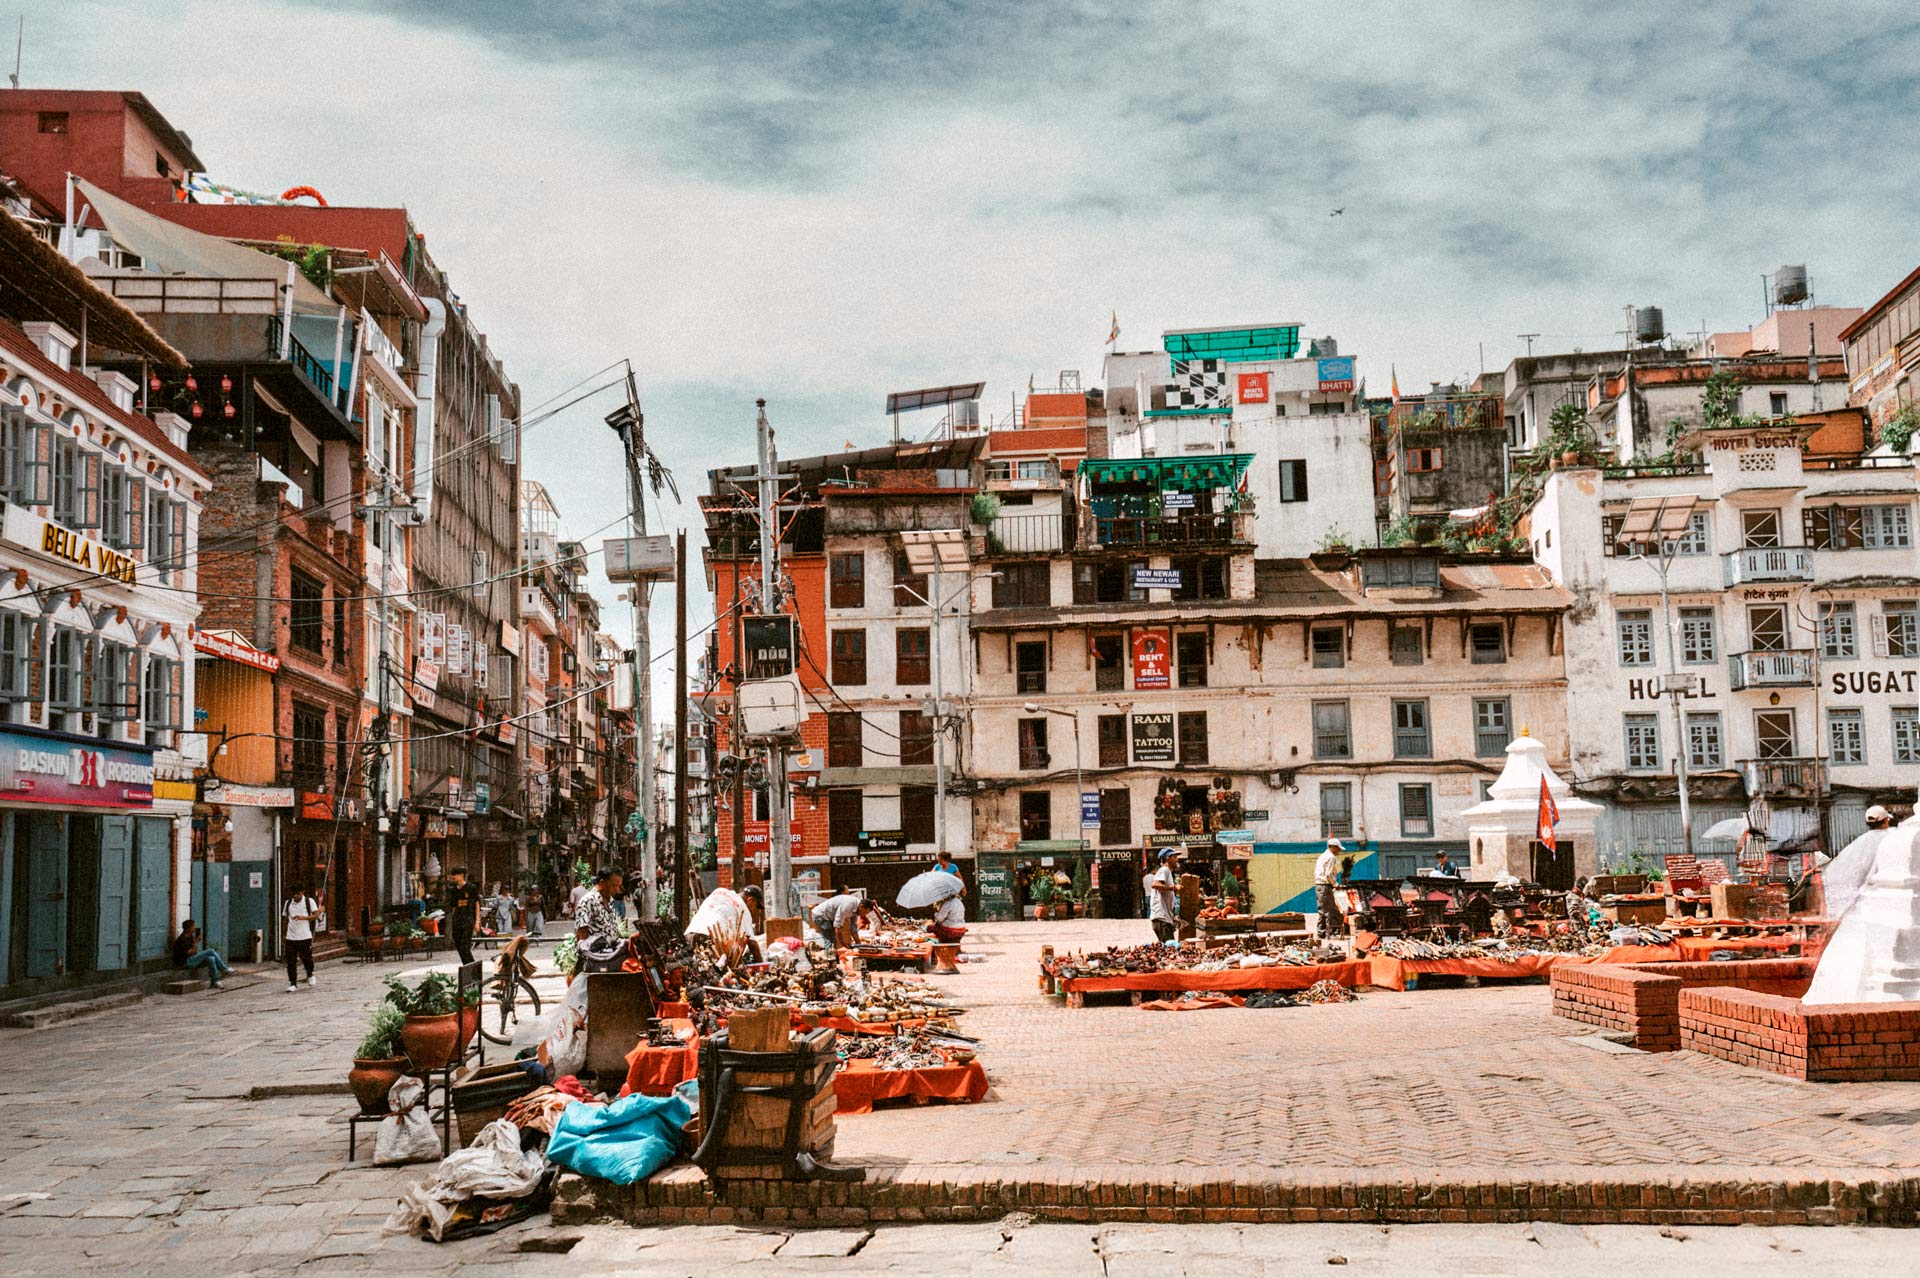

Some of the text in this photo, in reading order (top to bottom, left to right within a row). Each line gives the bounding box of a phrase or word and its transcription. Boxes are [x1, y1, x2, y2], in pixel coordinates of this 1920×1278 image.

[1321, 381, 1351, 391] BHATTI
[41, 522, 137, 588] BELLA VISTA
[1139, 653, 1164, 662] RENT
[1148, 661, 1155, 669] &
[1141, 668, 1164, 676] SELL
[1832, 670, 1917, 695] SUGAT
[1134, 715, 1171, 724] RAAN
[1134, 738, 1173, 747] TATTOO
[16, 749, 69, 776] BASKIN
[106, 761, 154, 785] ROBBINS
[744, 834, 768, 843] MONEY
[1101, 851, 1132, 859] TATTOO
